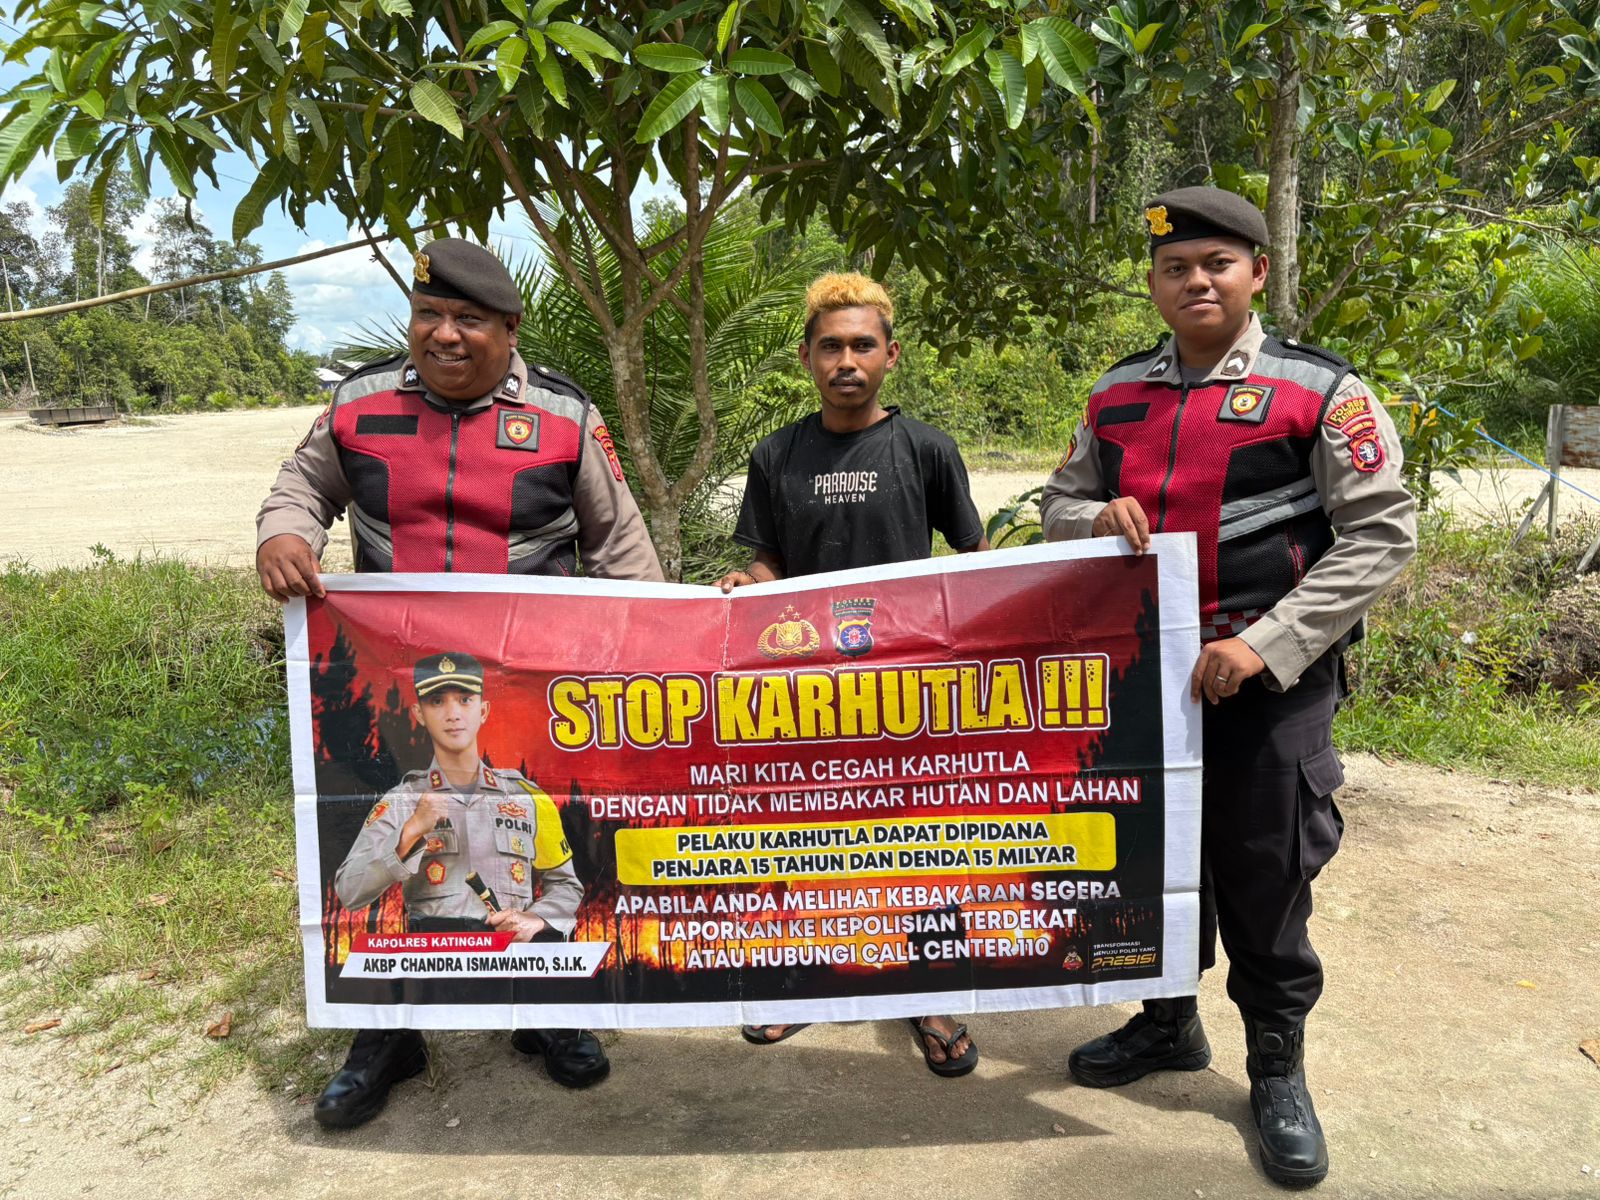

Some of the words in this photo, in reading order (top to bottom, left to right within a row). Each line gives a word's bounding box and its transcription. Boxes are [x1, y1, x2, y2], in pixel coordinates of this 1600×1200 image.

[814, 471, 878, 495] PARADISE
[824, 493, 866, 504] HEAVEN
[551, 676, 703, 747] STOP
[715, 662, 1031, 742] KARHUTLA
[1040, 658, 1106, 726] !!!
[690, 764, 748, 786] MARI
[755, 761, 805, 783] KITA
[812, 757, 894, 781] CEGAH
[901, 751, 1031, 777] KARHUTLA
[591, 795, 687, 818] DENGAN
[694, 793, 763, 815] TIDAK
[770, 787, 905, 813] MEMBAKAR
[912, 783, 990, 806] HUTAN
[999, 781, 1048, 804] DAN
[1056, 779, 1139, 803] LAHAN
[496, 818, 532, 834] POLRI
[677, 831, 755, 852] PELAKU
[760, 826, 869, 850] KARHUTLA
[874, 823, 941, 844] DAPAT
[945, 821, 1048, 842] DIPIDANA
[653, 857, 748, 878] PENJARA
[751, 858, 770, 875] 15
[774, 853, 845, 874] TAHUN
[850, 851, 894, 871] DAN
[899, 849, 970, 868] DENDA
[973, 849, 993, 866] 15
[998, 846, 1076, 866] MILYAR
[614, 894, 708, 915] APABILA
[712, 892, 778, 914] ANDA
[782, 888, 880, 911] MELIHAT
[886, 882, 1025, 907] KEBAKARAN
[1031, 881, 1121, 901] SEGERA
[659, 919, 783, 942] LAPORKAN
[789, 918, 816, 938] KE
[821, 912, 956, 937] KEPOLISIAN
[961, 908, 1077, 931] TERDEKAT
[367, 936, 428, 948] KAPOLRES
[431, 936, 493, 947] KATINGAN
[686, 947, 745, 969] ATAU
[751, 943, 856, 968] HUBUNGI
[861, 941, 919, 964] CALL
[923, 938, 1013, 961] CENTER
[1016, 936, 1049, 957] 110
[1093, 941, 1141, 950] TRANSFORMASI
[363, 957, 397, 973] AKBP
[400, 957, 464, 972] CHANDRA
[466, 957, 549, 974] ISMAWANTO,
[552, 956, 587, 972] S.I.K.
[1091, 953, 1157, 969] PRESISI
